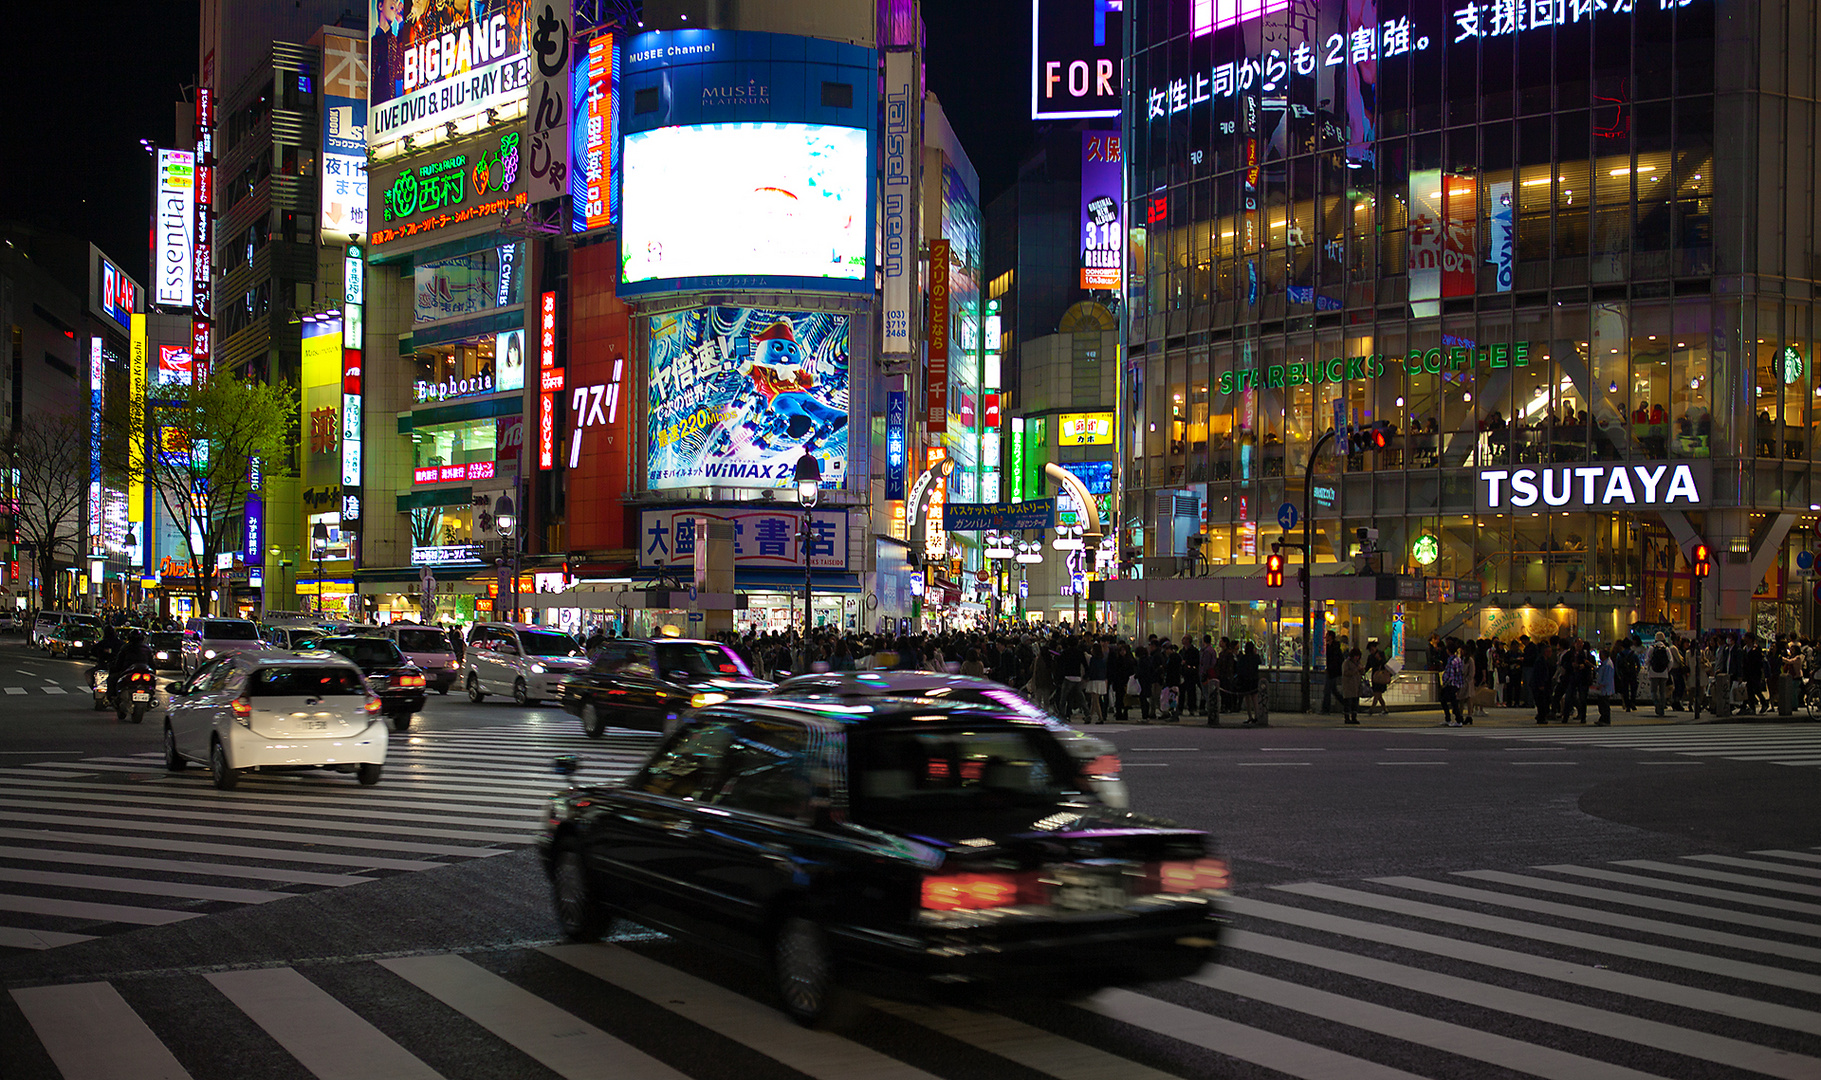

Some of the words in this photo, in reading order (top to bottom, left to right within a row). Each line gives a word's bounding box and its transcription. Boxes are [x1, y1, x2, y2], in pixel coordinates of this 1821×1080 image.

[403, 14, 507, 89] BIGBANG
[629, 48, 664, 63] MUSEE
[667, 42, 716, 57] Channel
[1148, 19, 1430, 121] 女性上司からも2割強。
[532, 5, 569, 192] もんじゃ
[1046, 58, 1123, 98] FOR
[329, 109, 340, 135] BOOK
[374, 102, 398, 135] LIVE
[401, 93, 426, 123] DVD
[428, 89, 438, 116] &
[441, 70, 499, 110] BLU-RAY
[702, 98, 770, 106] PLATINUM
[585, 42, 605, 218] 三千里薬品
[886, 83, 910, 186] Taisei
[336, 179, 367, 197] まで
[418, 168, 466, 212] 西村
[1088, 197, 1113, 212] ORIGINAL
[160, 189, 186, 303] Essential
[886, 193, 904, 278] neon
[1085, 221, 1121, 251] 3.18
[702, 277, 769, 288] ミュゼプラチナム
[932, 245, 946, 350] クスリのことなら
[886, 320, 907, 330] 3719
[886, 329, 907, 339] 2468
[887, 310, 905, 320] (03)
[417, 373, 493, 403] Euphoria
[929, 358, 947, 421] 三千里
[1219, 353, 1385, 395] STARBUCKS
[1402, 342, 1530, 375] COFFEE
[310, 406, 338, 454] 薬
[889, 399, 904, 493] 大盛堂商事ビル
[705, 463, 774, 479] WiMAX
[1480, 464, 1700, 508] TSUTAYA
[949, 501, 1051, 516] バスケットボールストリート
[647, 517, 837, 557] 大盛書店
